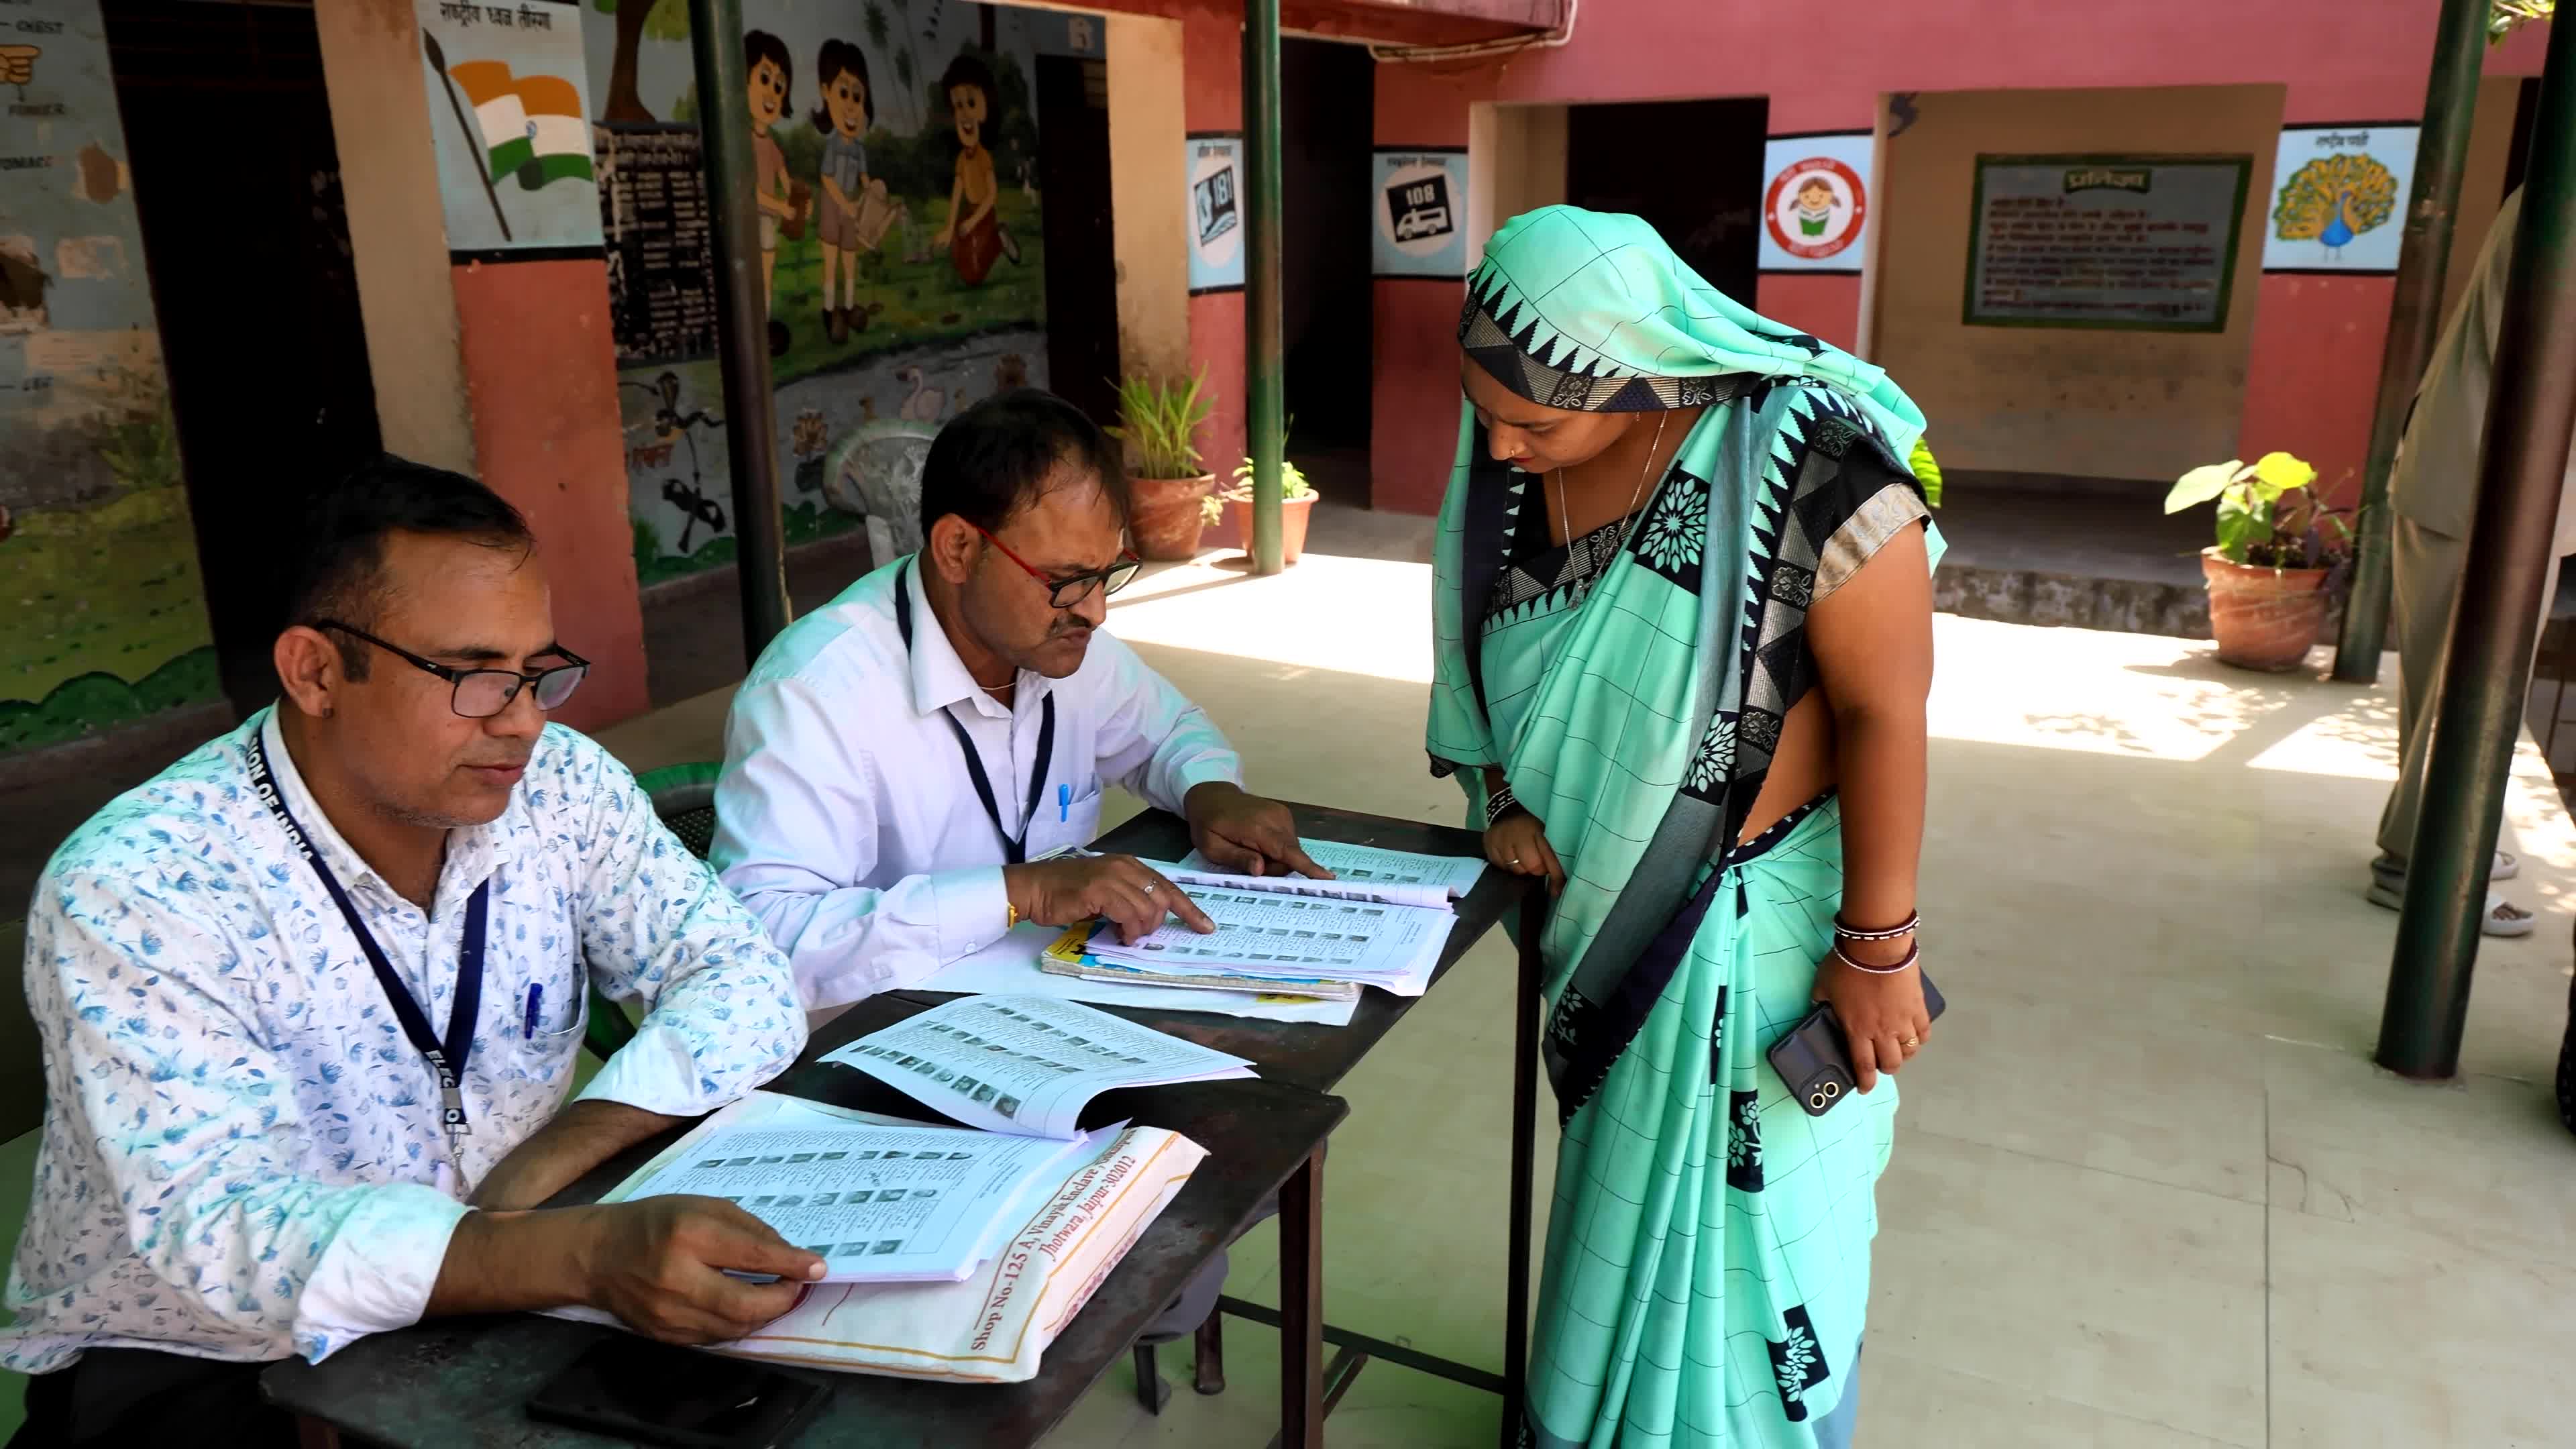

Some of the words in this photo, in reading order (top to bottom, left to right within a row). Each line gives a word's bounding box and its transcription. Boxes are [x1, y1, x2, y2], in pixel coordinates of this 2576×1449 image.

[1405, 182, 1436, 207] 108
[258, 783, 280, 807] OF
[276, 810, 313, 861] INDIA
[1075, 1155, 1136, 1220] Jaipur-302012
[971, 1311, 1003, 1351] Shop
[1026, 1201, 1071, 1236] Vinayak
[1061, 1167, 1099, 1201] Enclave
